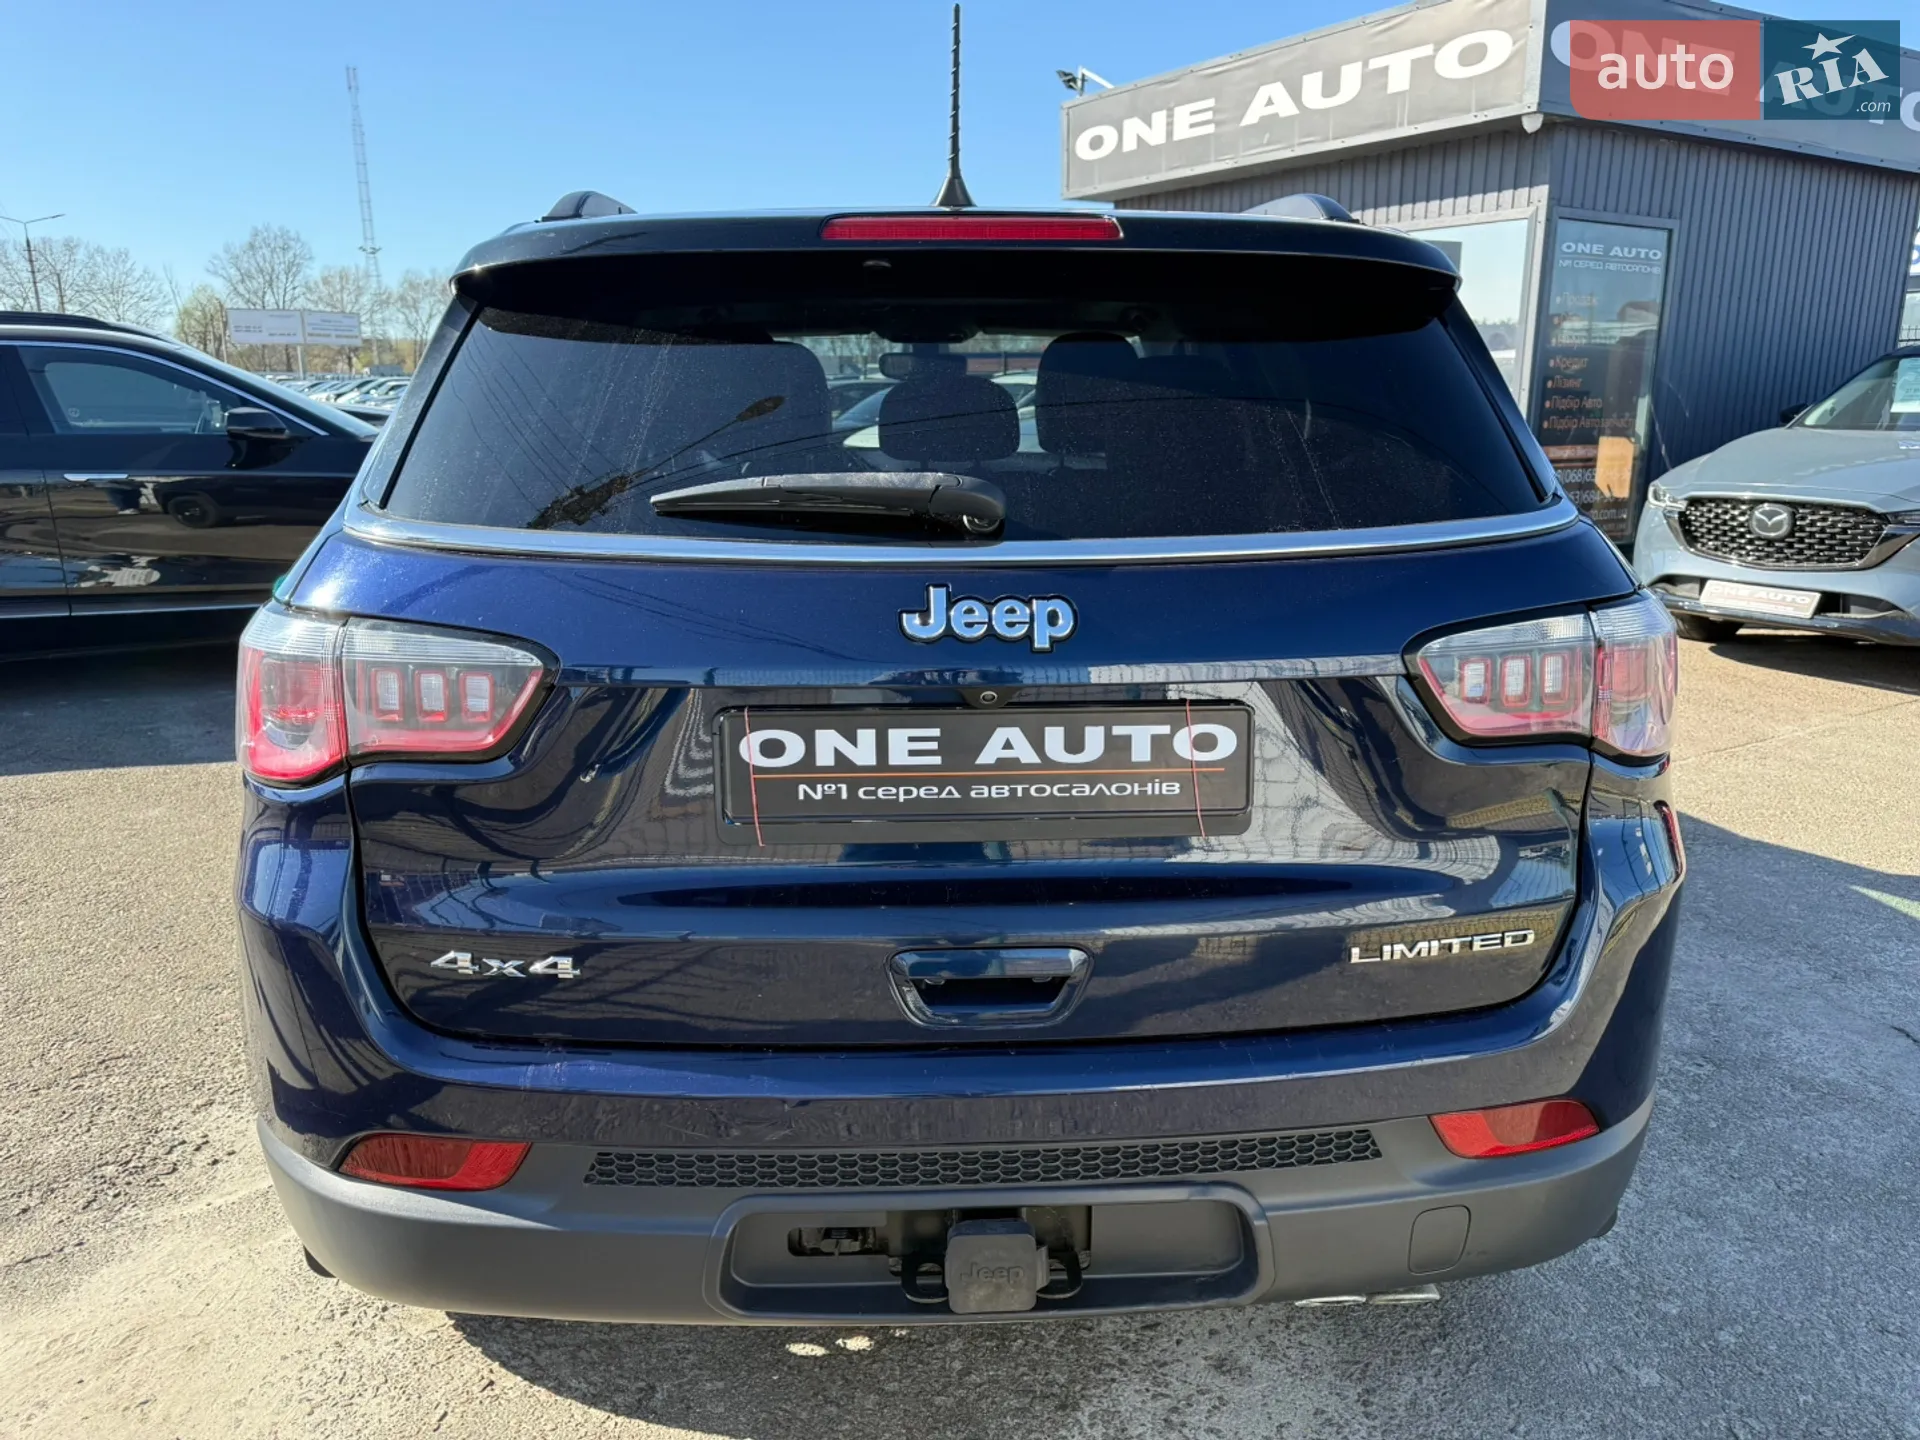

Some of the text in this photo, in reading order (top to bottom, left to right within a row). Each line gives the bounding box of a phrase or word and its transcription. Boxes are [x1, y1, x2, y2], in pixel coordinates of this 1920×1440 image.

[1074, 29, 1514, 161] ONE AUTO
[1560, 242, 1662, 260] ONE AUTO
[1550, 395, 1603, 411] Підбір Авто
[1548, 416, 1578, 430] Підбір
[1753, 589, 1811, 604] AUTO
[901, 584, 1075, 651] Jeep
[738, 723, 1238, 768] ONE AUTO
[797, 778, 1181, 803] №1 серед автосалонів
[1350, 929, 1535, 964] LIMITED
[430, 950, 582, 979] 4x4
[960, 1262, 1025, 1285] Jeep
